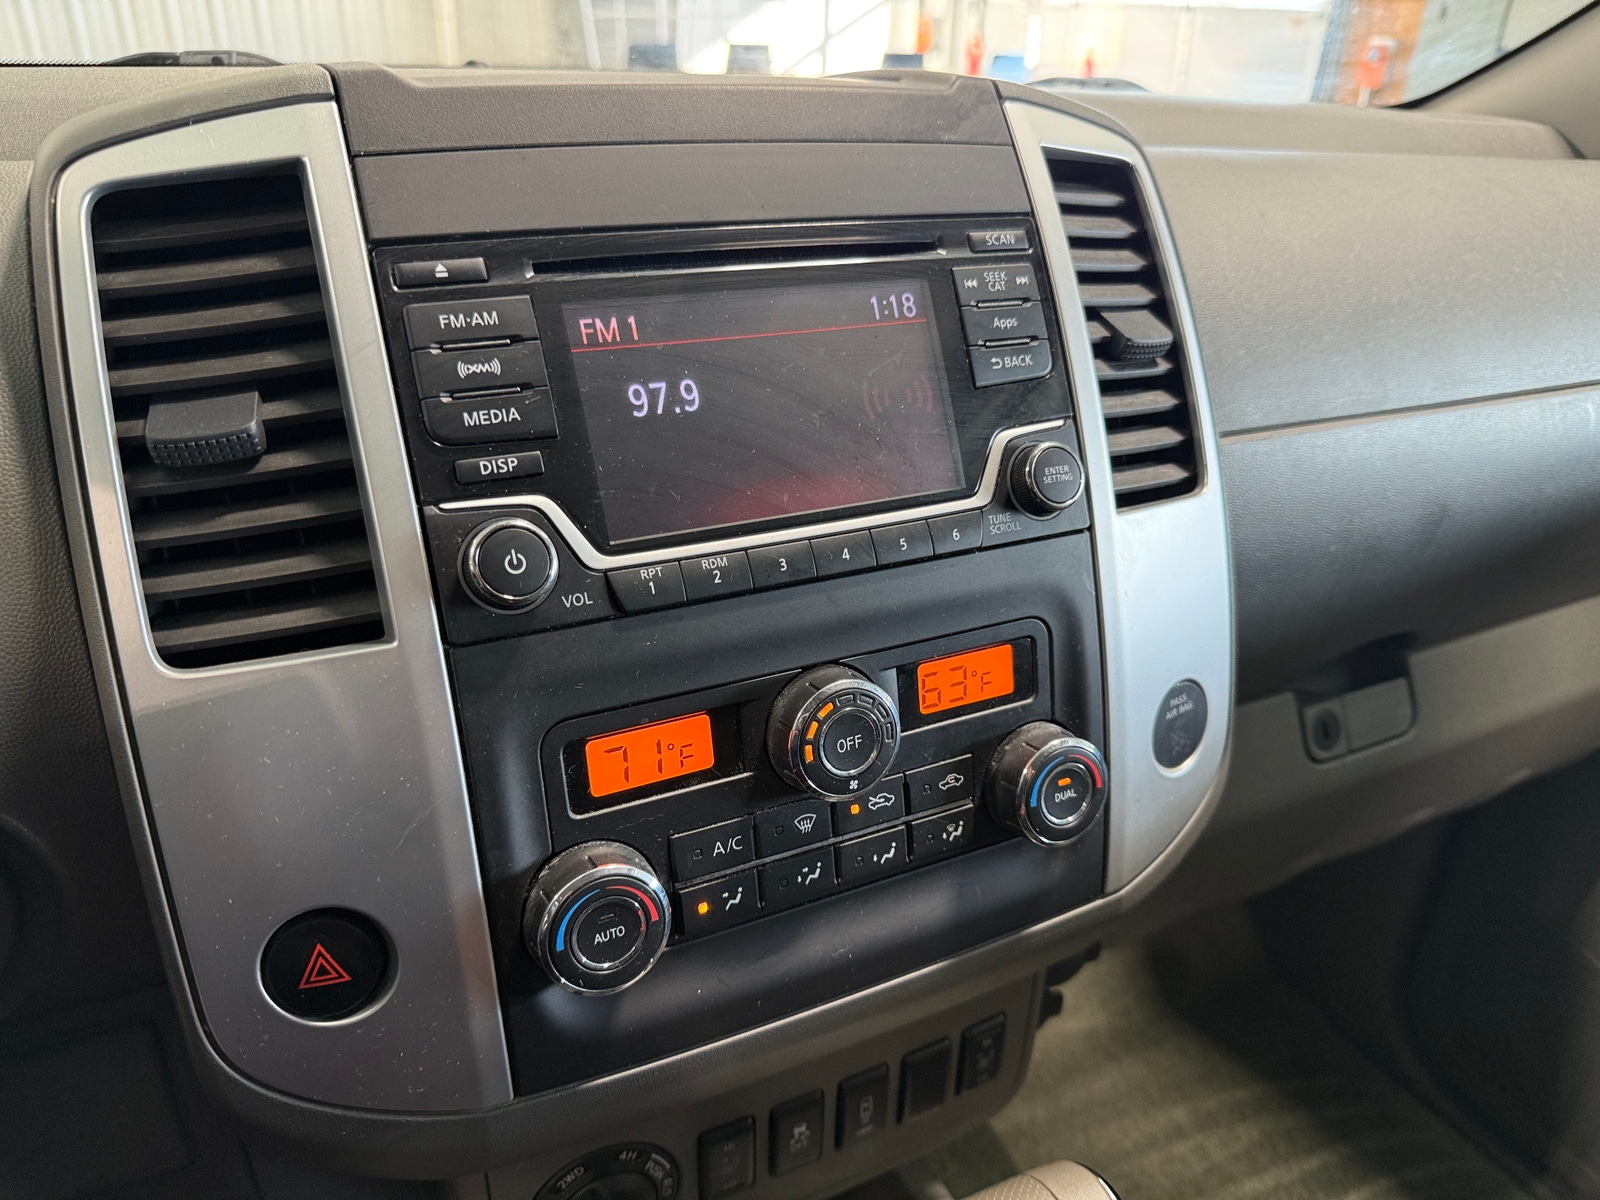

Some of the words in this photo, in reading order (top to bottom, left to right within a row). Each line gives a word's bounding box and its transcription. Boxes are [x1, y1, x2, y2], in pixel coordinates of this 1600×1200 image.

[985, 234, 1015, 246] SCAN
[983, 271, 1007, 282] SEEK
[988, 281, 1006, 292] CAT
[870, 292, 917, 320] 1:18
[578, 317, 621, 344] FM
[627, 315, 639, 340] 1
[993, 317, 1018, 330] Apps
[1004, 354, 1033, 368] BACK
[627, 378, 701, 418] 97.9
[463, 407, 521, 427] MEDIA
[479, 457, 518, 475] DISP
[1044, 465, 1070, 476] ENTER
[1043, 473, 1073, 484] SETTING
[988, 512, 1012, 525] TUNE
[952, 528, 960, 541] 6
[989, 522, 1022, 535] SCROLL
[900, 538, 908, 551] 5
[842, 548, 851, 561] 4
[701, 557, 729, 570] RDM
[779, 558, 788, 572] 3
[640, 567, 663, 580] RPT
[713, 569, 722, 584] 2
[648, 581, 656, 595] 1
[562, 592, 594, 609] VOL
[1169, 692, 1188, 708] PASS
[1165, 707, 1178, 720] AIR
[1178, 700, 1193, 714] BAG
[836, 734, 863, 753] OFF
[1054, 788, 1077, 803] DUAL
[712, 835, 743, 858] A/C
[593, 925, 626, 946] AUTO
[556, 1166, 585, 1190] 2WD
